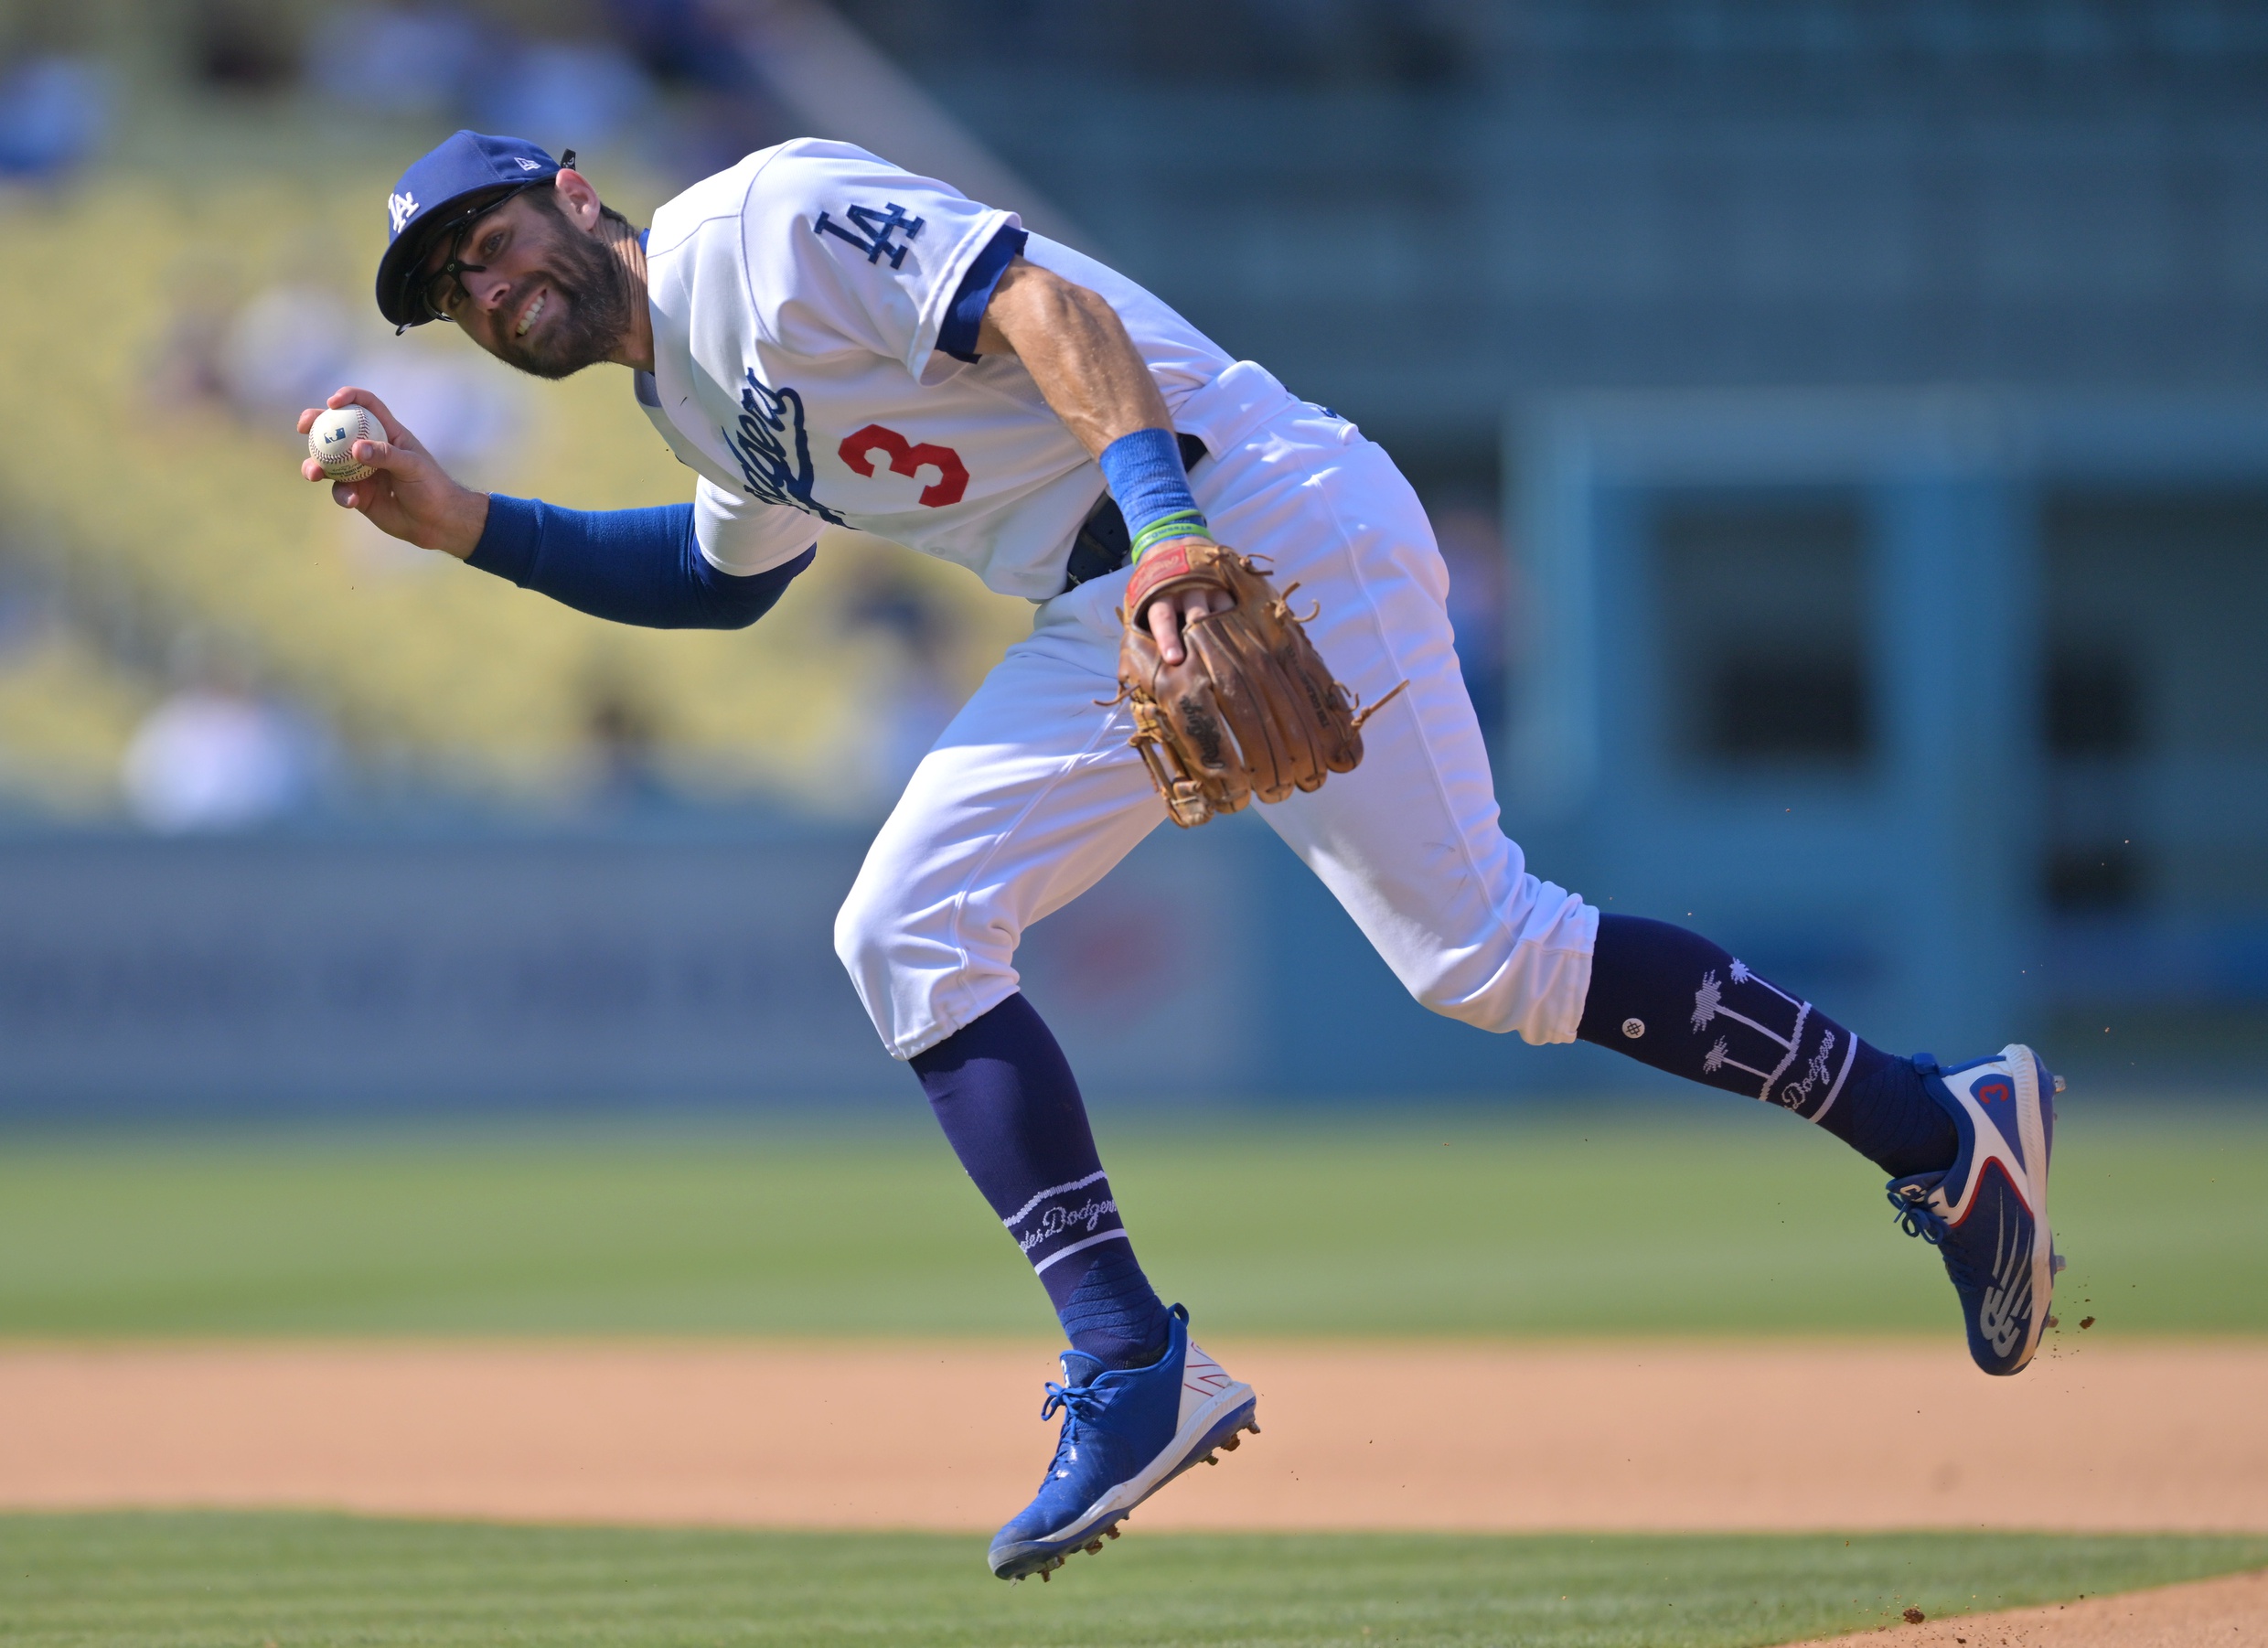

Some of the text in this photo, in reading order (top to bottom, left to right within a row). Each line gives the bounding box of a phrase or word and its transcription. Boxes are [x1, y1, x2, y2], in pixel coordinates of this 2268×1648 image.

[388, 190, 420, 233] LA
[813, 201, 925, 270] LA
[838, 423, 970, 508] 3
[1978, 1083, 2009, 1105] 3
